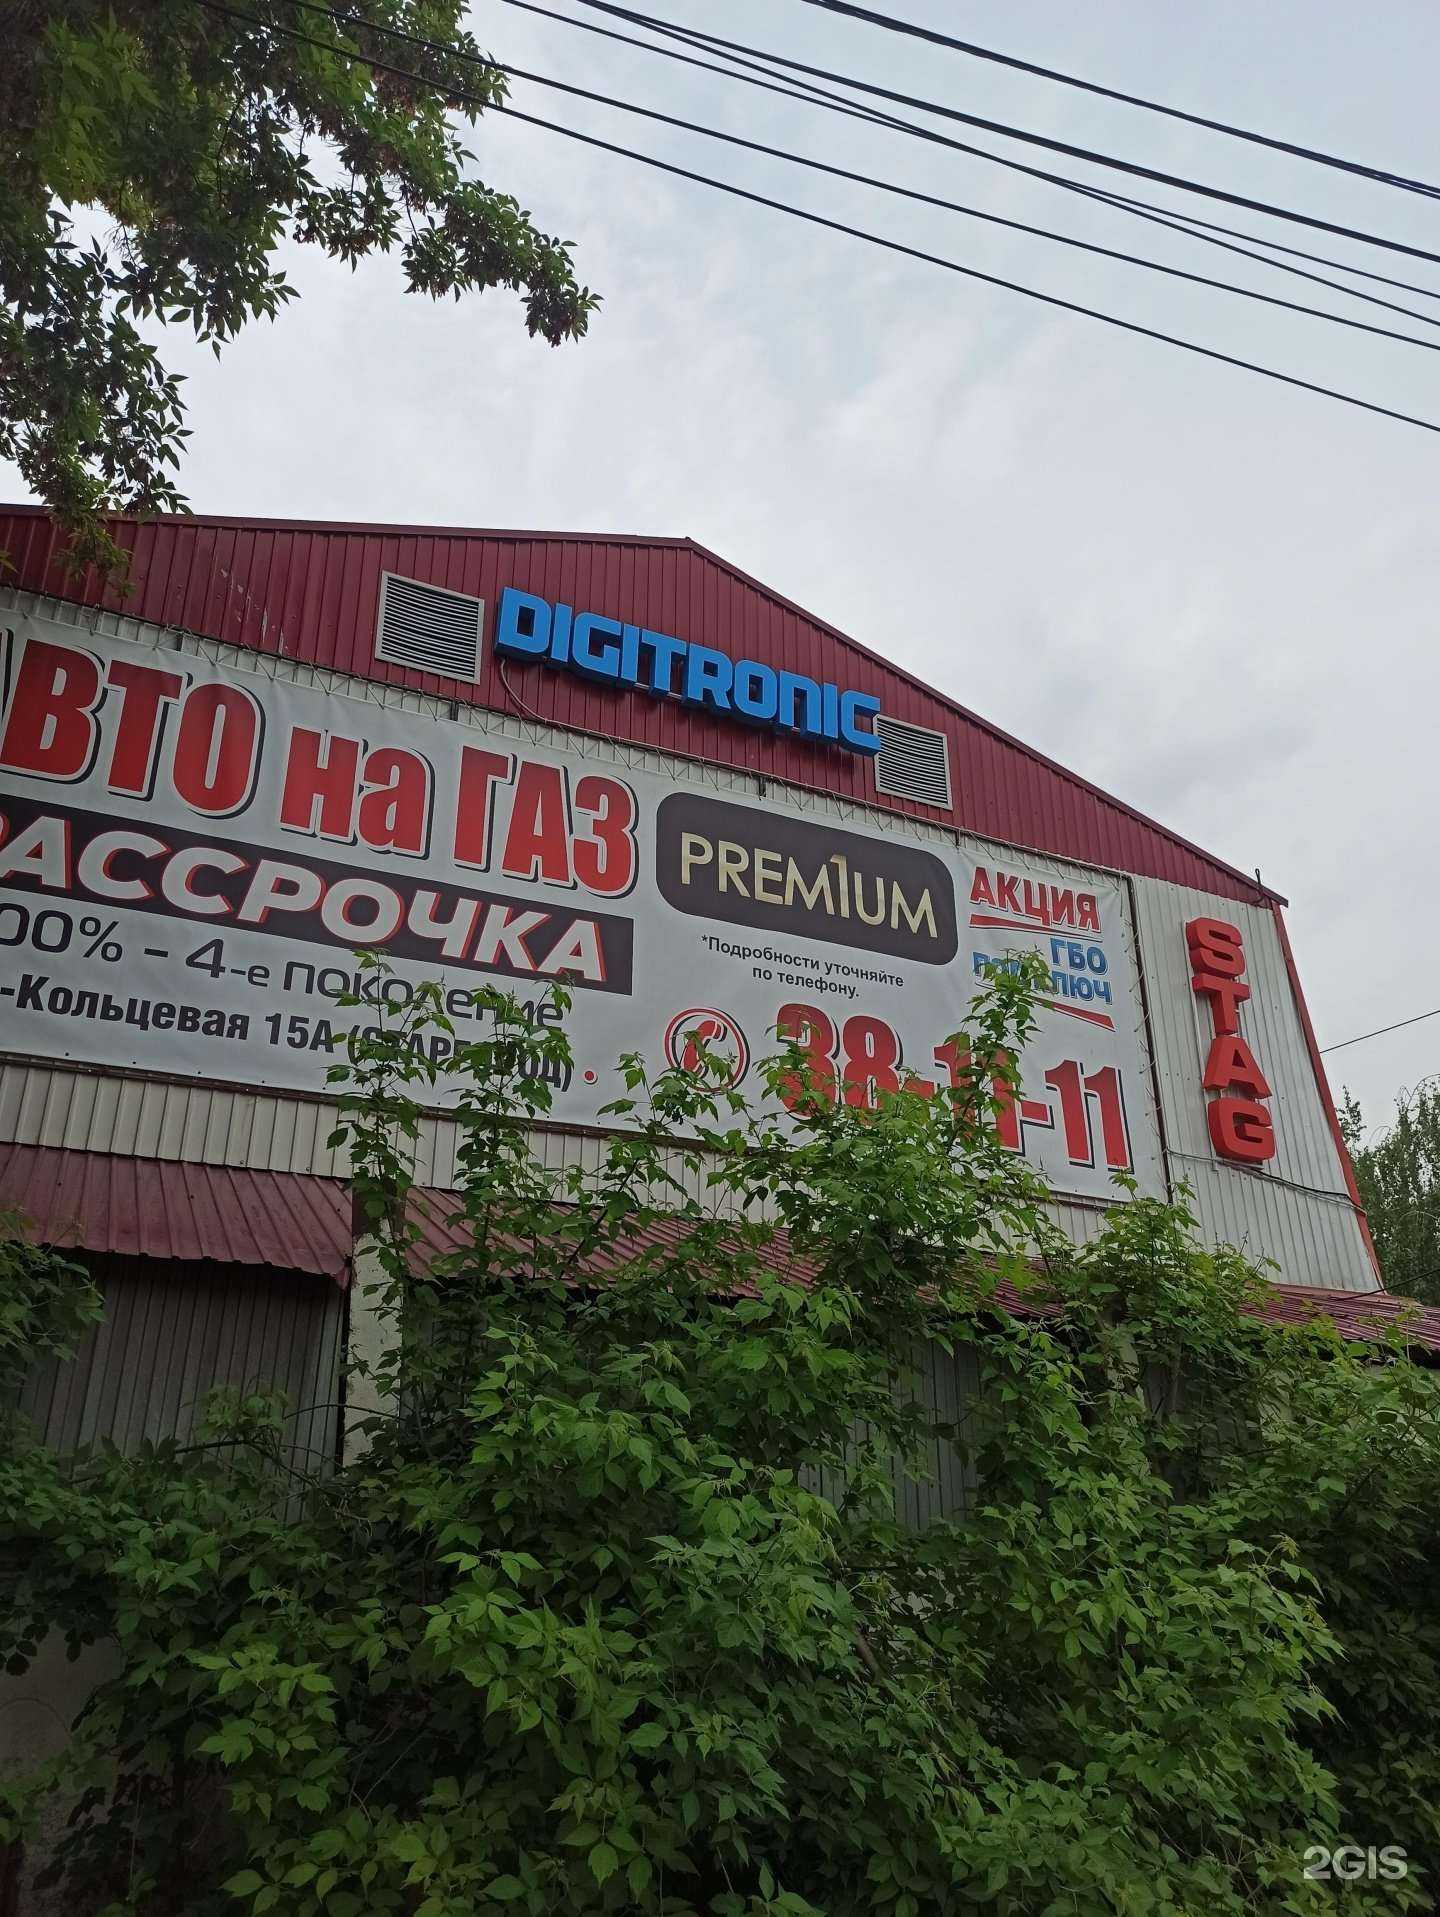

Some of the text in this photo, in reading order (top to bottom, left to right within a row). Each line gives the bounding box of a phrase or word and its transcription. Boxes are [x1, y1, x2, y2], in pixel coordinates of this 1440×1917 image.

[497, 586, 882, 756] DIGITRONIC
[0, 628, 640, 899] ВТО на ГАЗ
[0, 813, 606, 982] АССРОЧКА
[969, 866, 1101, 933] АКЦИЯ
[752, 967, 860, 999] по телефону.
[825, 961, 904, 987] уточняйте
[1032, 969, 1113, 1005] ЛЮЧ
[1050, 937, 1110, 976] ГБО
[283, 961, 564, 1031] покоение
[265, 1012, 334, 1054] 15А
[1185, 916, 1276, 1163] STAG
